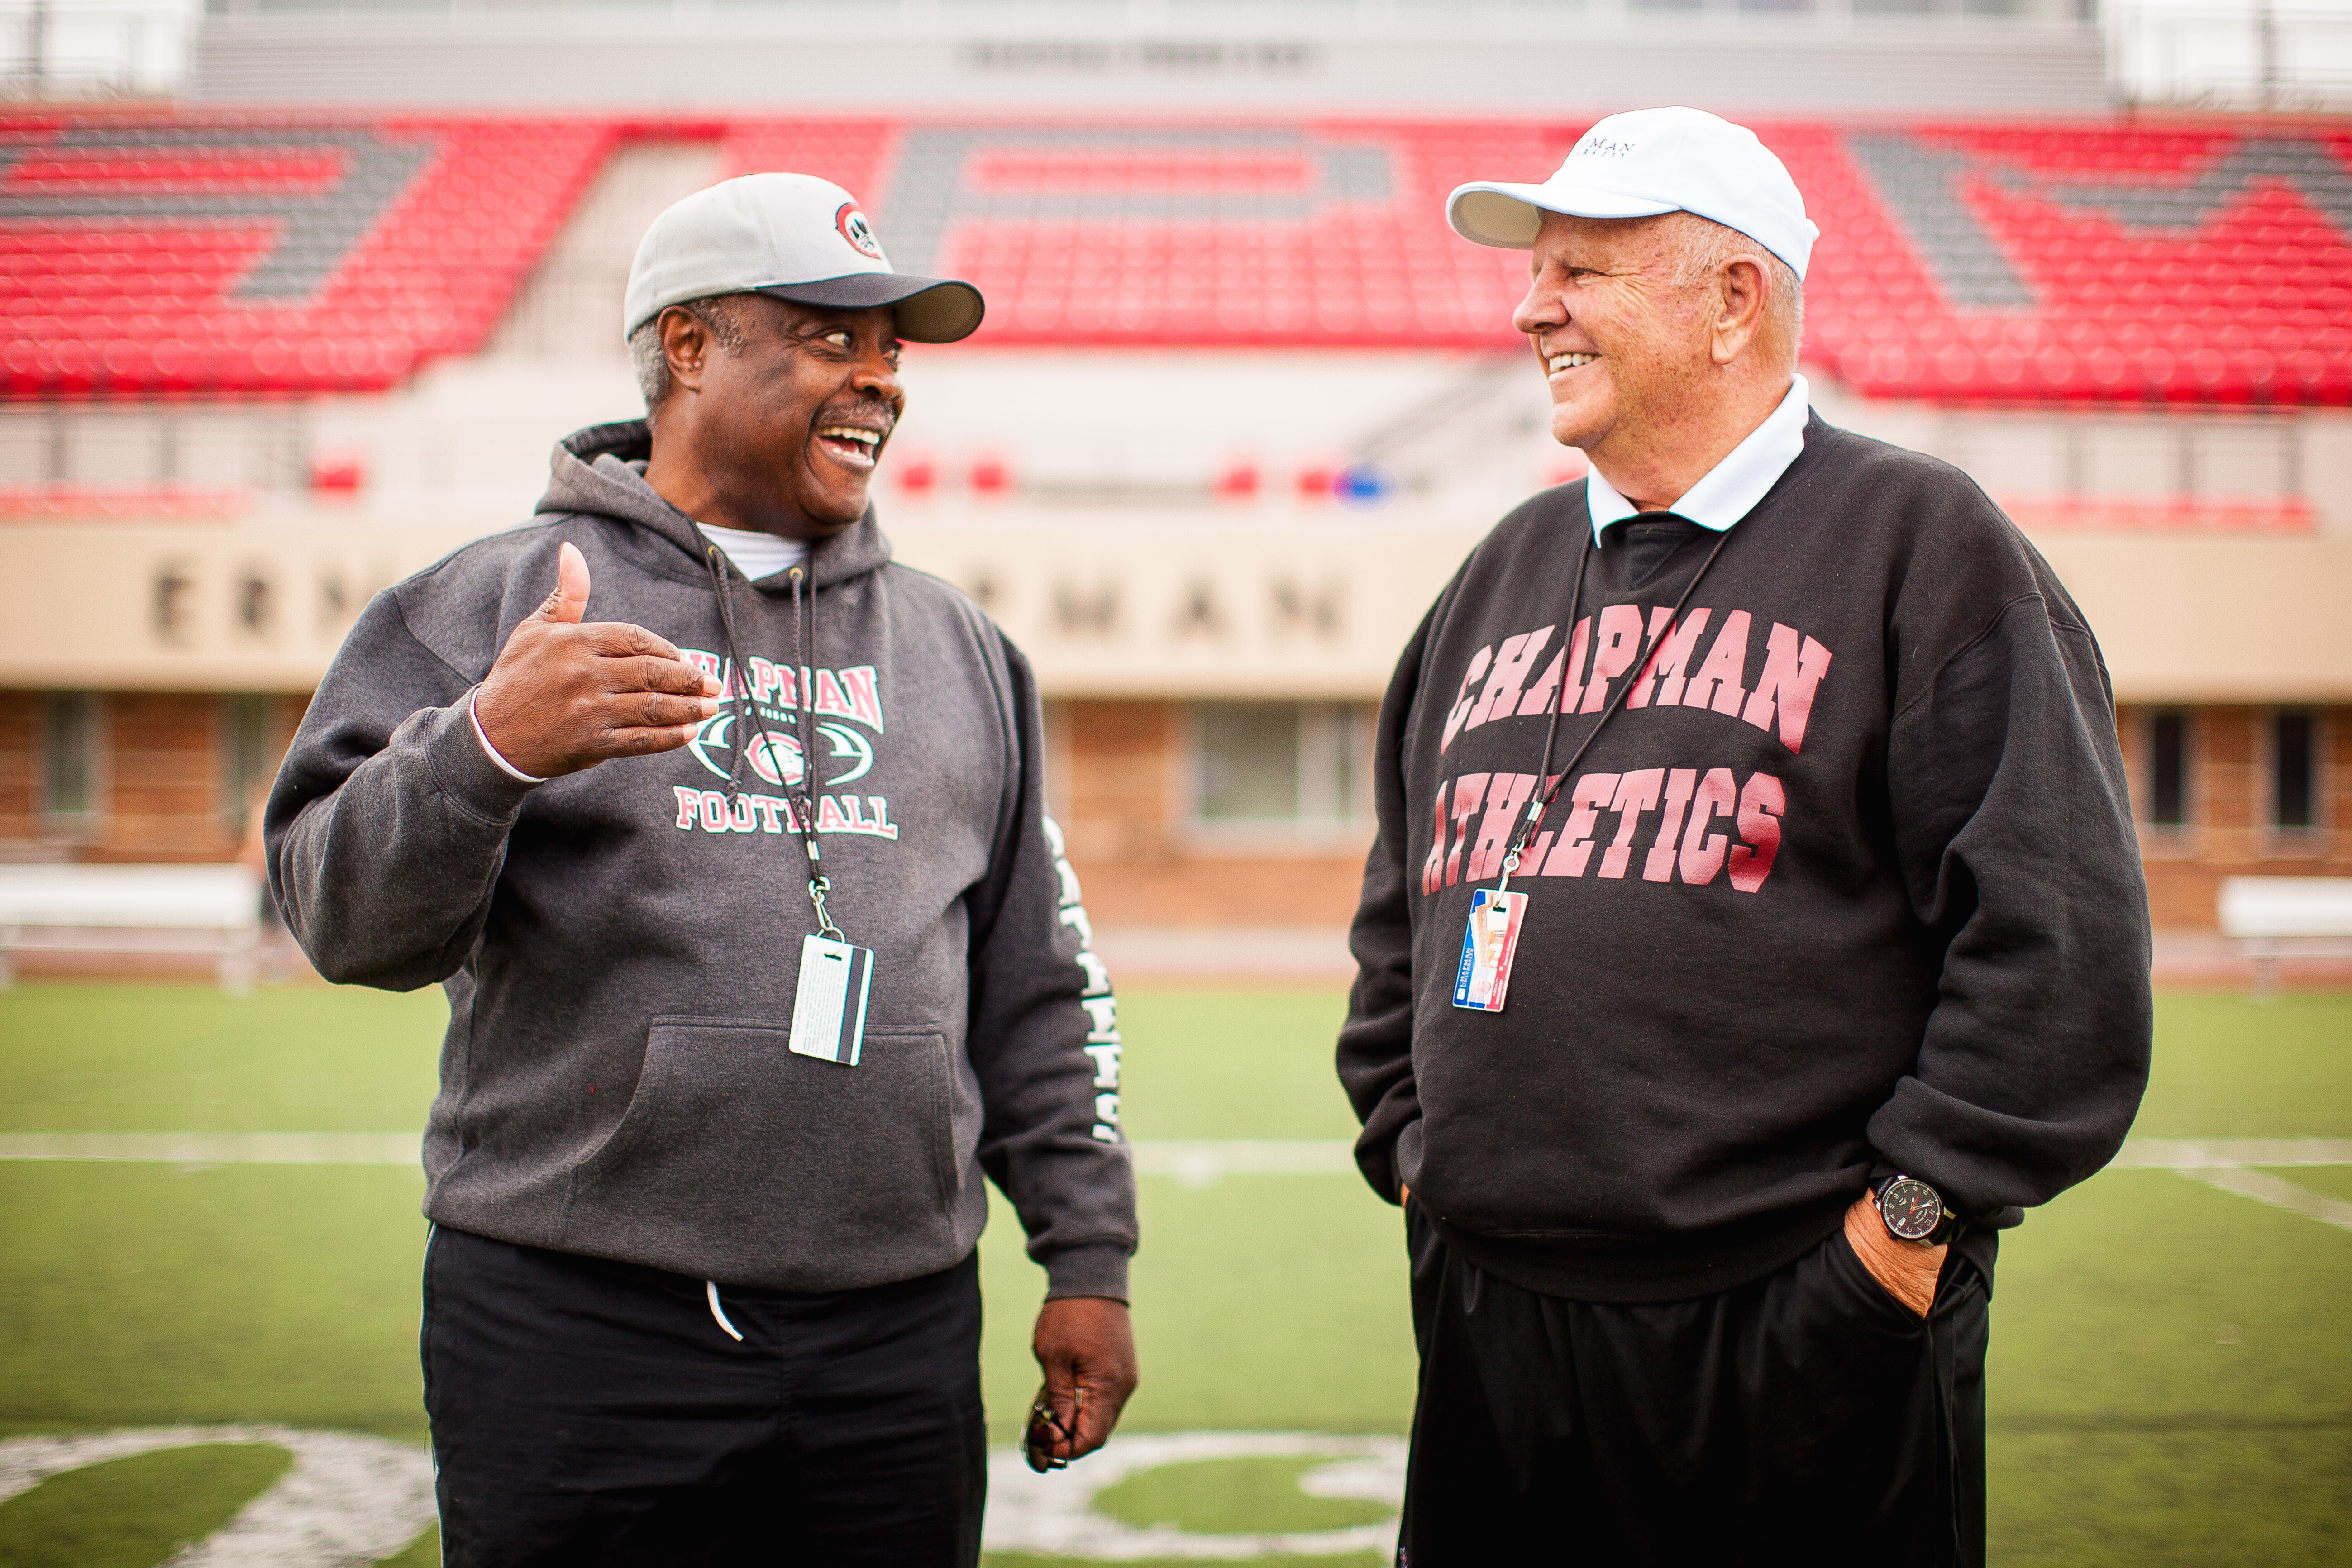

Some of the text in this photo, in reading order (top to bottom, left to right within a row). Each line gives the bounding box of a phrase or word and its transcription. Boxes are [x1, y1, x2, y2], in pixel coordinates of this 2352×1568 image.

[1578, 138, 1635, 151] MAN
[679, 648, 884, 734] HAPMAN
[1441, 604, 1832, 755] CHAPMAN
[1422, 768, 1786, 896] ATHLETICS
